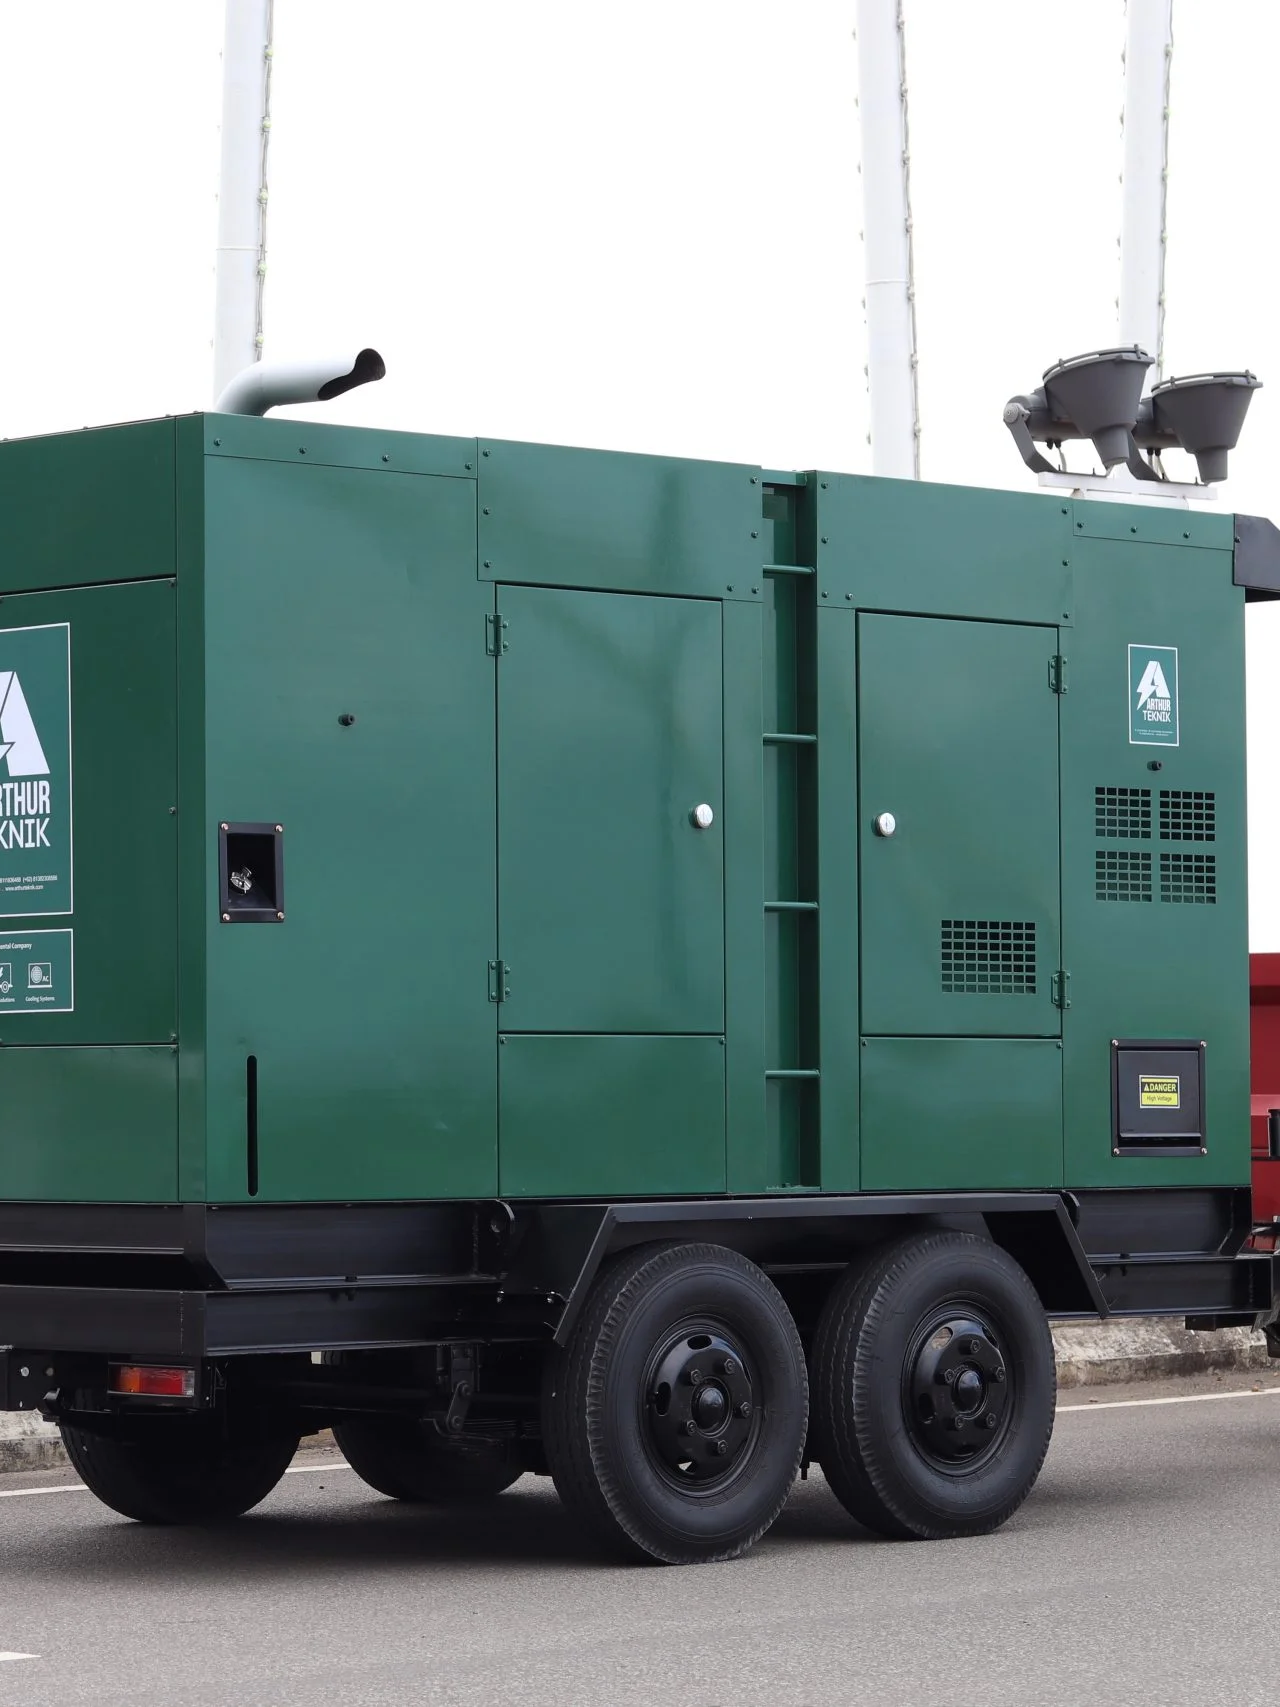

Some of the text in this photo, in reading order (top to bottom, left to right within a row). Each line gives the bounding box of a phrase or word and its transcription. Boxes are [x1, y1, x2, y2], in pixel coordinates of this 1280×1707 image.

[1146, 698, 1171, 711] ARTHUR
[1143, 711, 1171, 722] TEKNIK
[11, 942, 32, 950] Company
[25, 995, 55, 1003] Cooling Systems
[1149, 1083, 1177, 1092] DANGER
